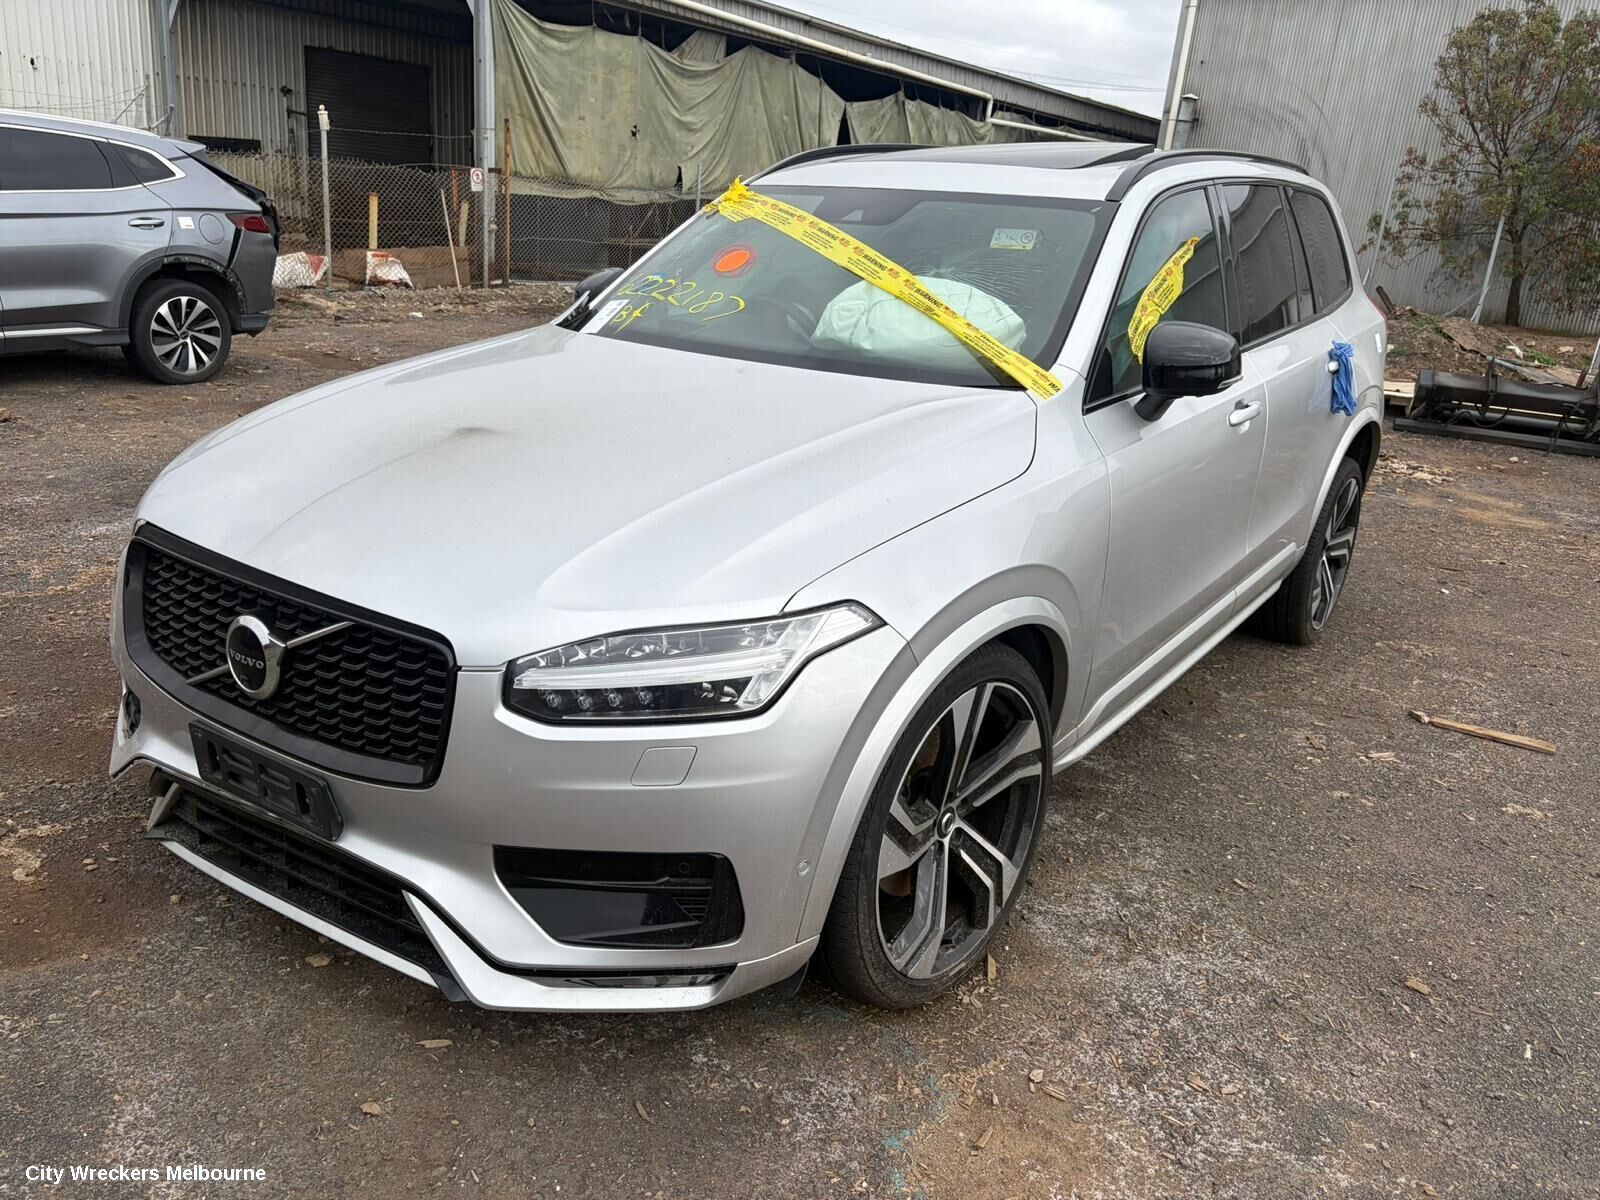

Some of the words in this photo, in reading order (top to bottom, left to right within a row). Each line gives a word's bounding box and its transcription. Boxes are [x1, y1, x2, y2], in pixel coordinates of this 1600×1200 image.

[861, 254, 888, 271] WARNING
[913, 287, 943, 309] WARNING
[229, 648, 265, 669] VOLVO
